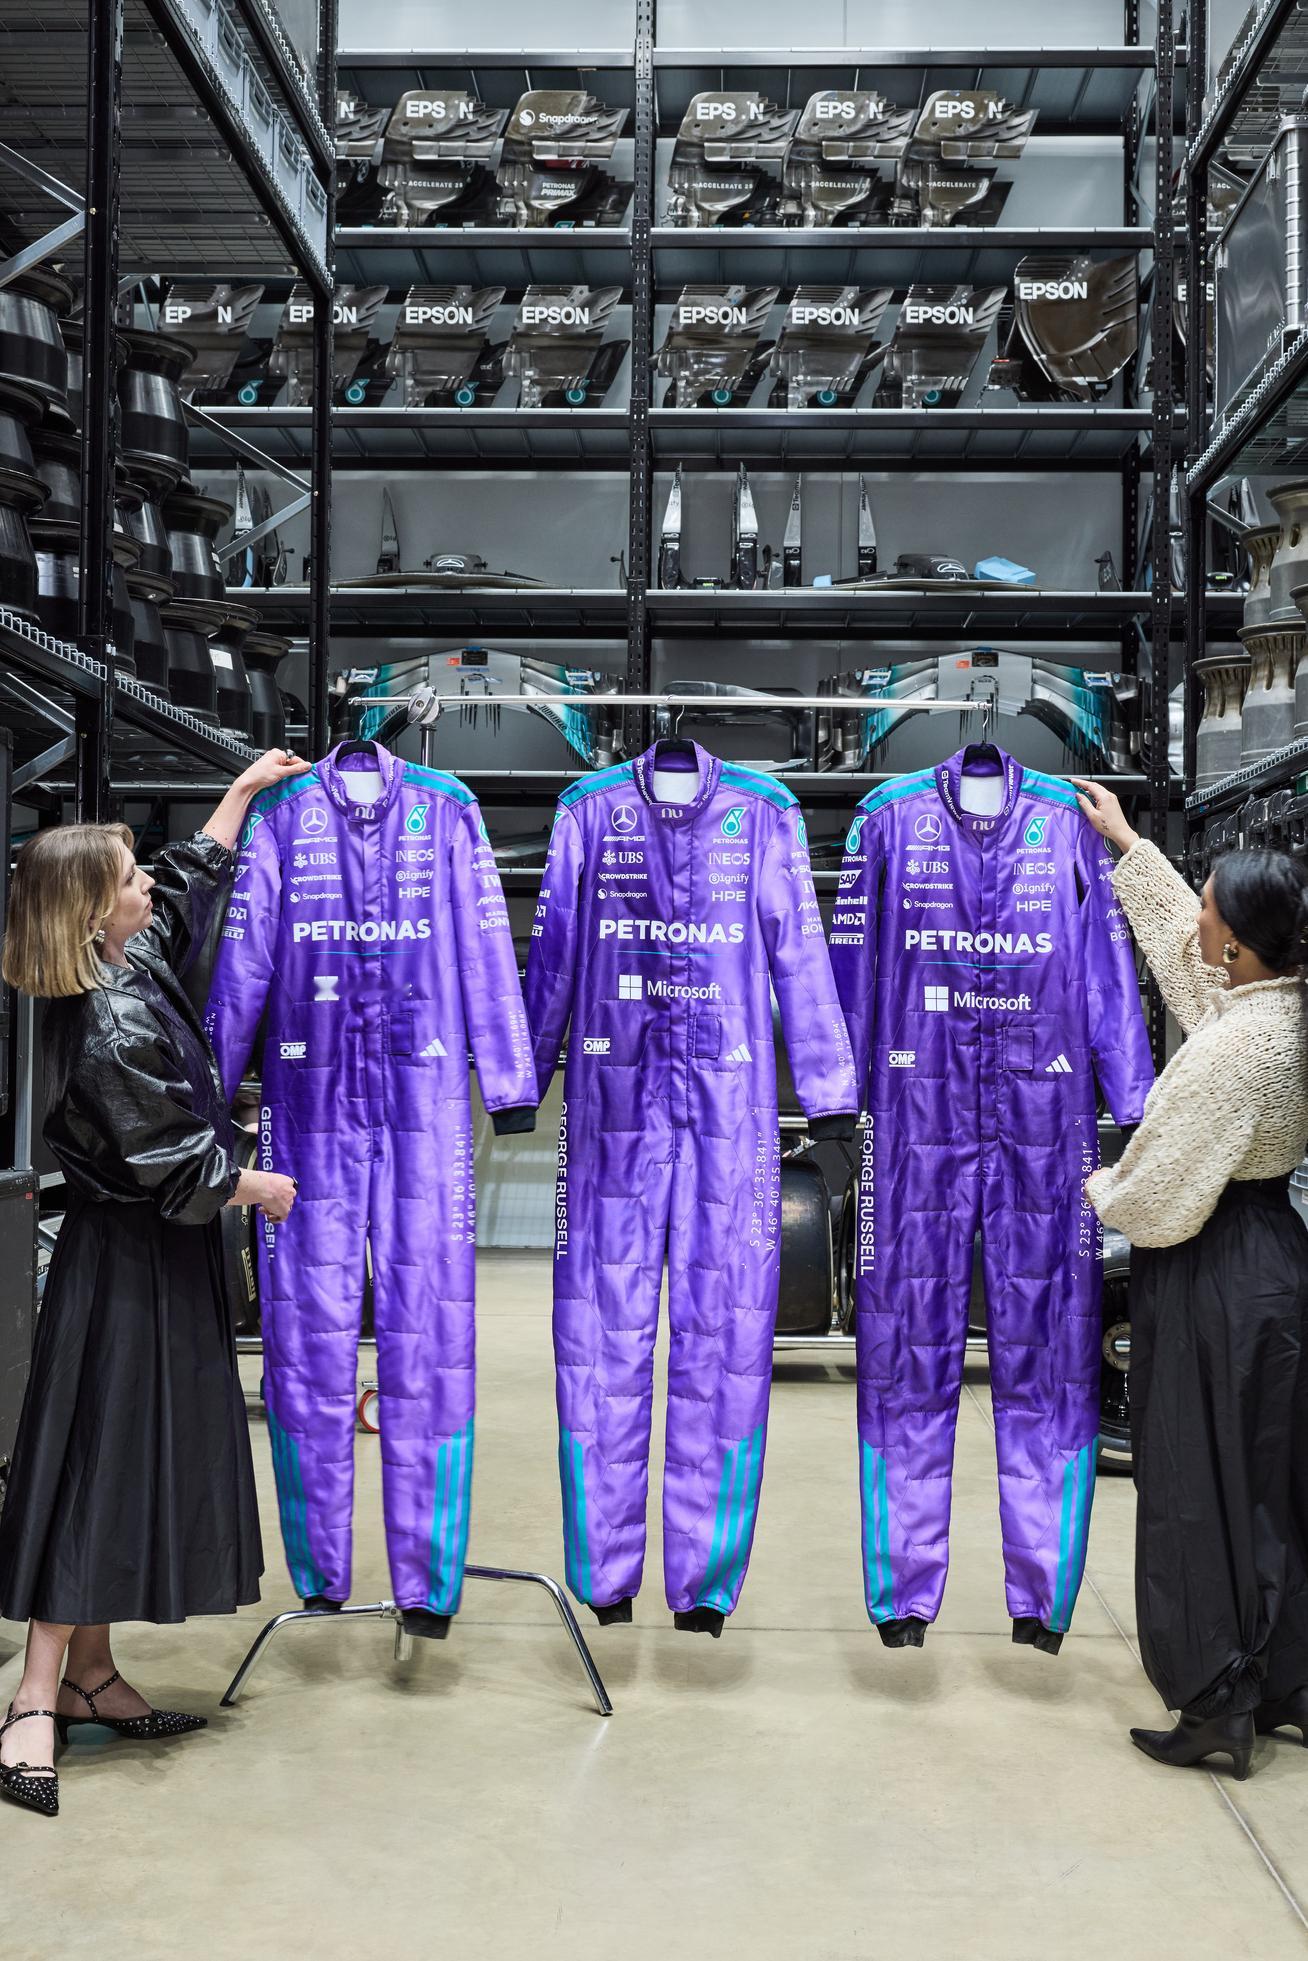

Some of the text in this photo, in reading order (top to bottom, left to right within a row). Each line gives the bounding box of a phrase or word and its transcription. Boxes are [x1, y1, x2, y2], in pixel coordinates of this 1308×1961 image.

[406, 100, 474, 120] EPSN
[696, 102, 764, 120] EPSN
[815, 101, 883, 120] EPSN
[935, 101, 1002, 119] EPSN
[408, 180, 453, 188] ACCELERATE
[1019, 281, 1088, 300] EPSON
[165, 306, 232, 324] EPN
[289, 305, 357, 324] EPON
[405, 307, 473, 325] EPSON
[522, 307, 589, 325] EPSON
[679, 305, 747, 325] EPSON
[791, 306, 860, 325] EPSON
[905, 306, 974, 325] EPSON
[398, 834, 431, 842] PETRONAS
[309, 852, 337, 865] UBS
[395, 849, 434, 862] INEOS
[618, 851, 644, 864] UBS
[708, 852, 750, 865] INEOS
[922, 861, 949, 874] UBS
[1013, 862, 1056, 875] INEOS
[294, 874, 342, 882] CROWDSTRIKE
[840, 876, 856, 886] SAP
[302, 891, 343, 900] Snapdragon
[398, 886, 431, 899] HPE
[609, 890, 648, 899] Snapdragon
[711, 890, 746, 902] HPE
[914, 900, 954, 910] Snapdragon
[1016, 900, 1052, 912] HPE
[293, 919, 431, 943] PETRONAS
[600, 919, 744, 943] PETRONAS
[905, 929, 1053, 954] PETRONAS
[647, 980, 721, 1000] Microsoft
[953, 991, 1031, 1011] Microsoft
[280, 1044, 307, 1057] OMP
[583, 1040, 611, 1052] OMP
[888, 1053, 916, 1064] OMP
[261, 1106, 274, 1171] GEORG
[860, 1115, 875, 1276] GEORGE RUSSELL
[556, 1182, 568, 1260] RUSSELL
[466, 1231, 476, 1244] W
[749, 1239, 760, 1247] S
[766, 1238, 775, 1251] W
[1079, 1249, 1090, 1257] S
[1095, 1247, 1104, 1260] W
